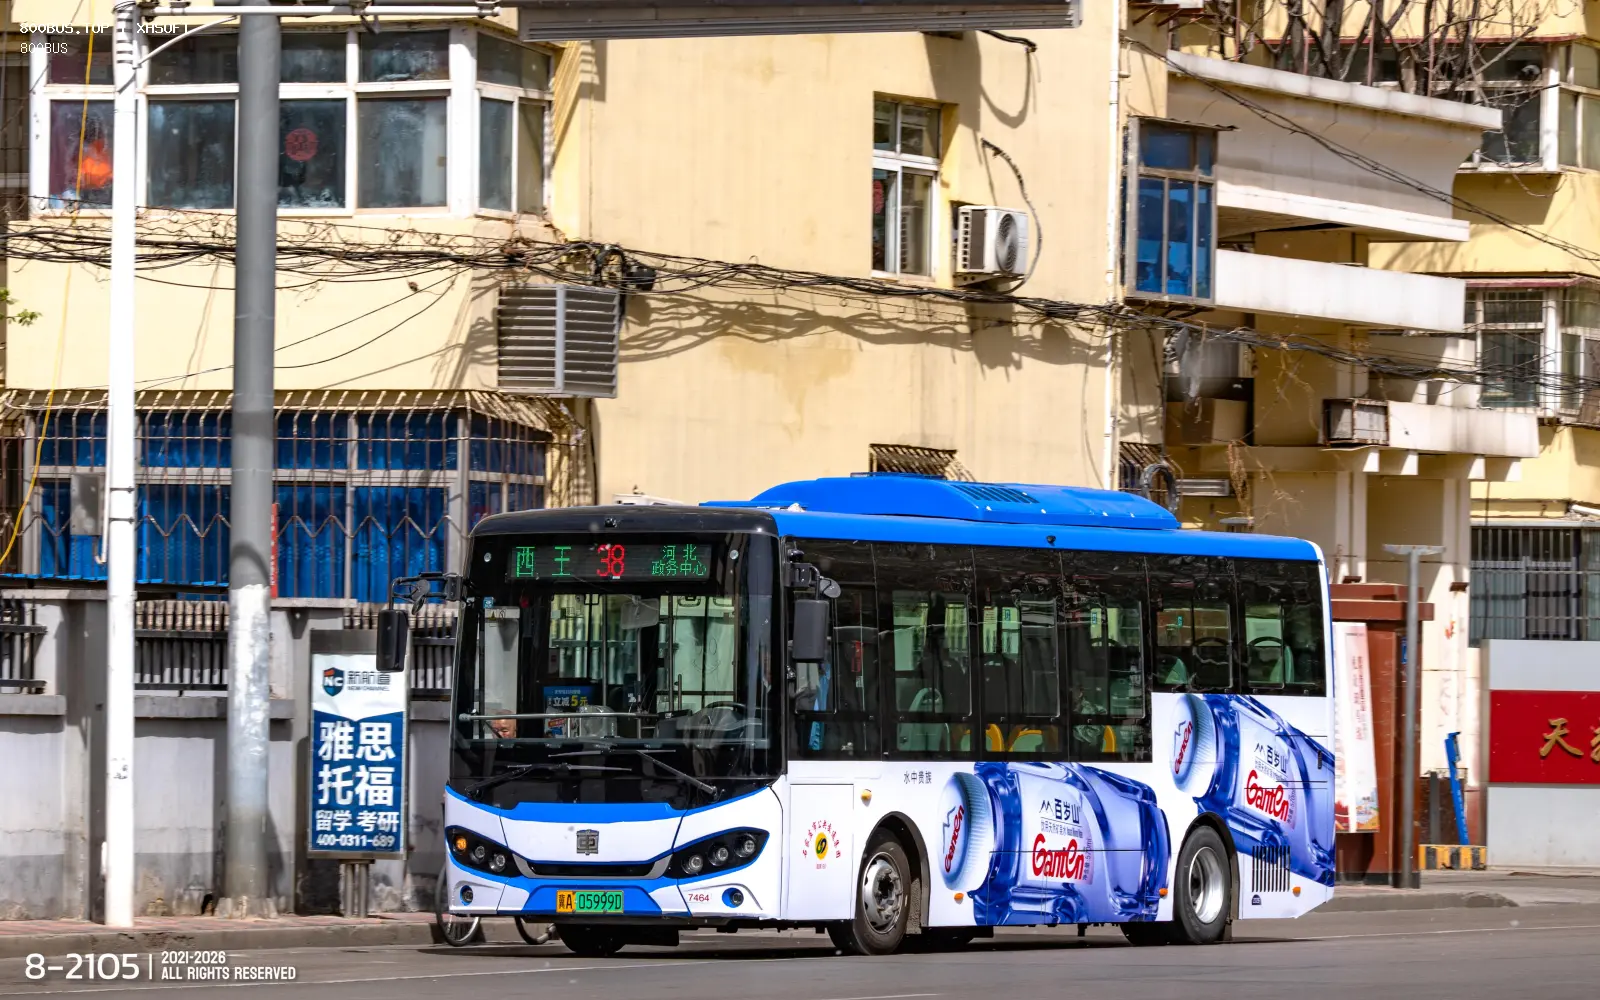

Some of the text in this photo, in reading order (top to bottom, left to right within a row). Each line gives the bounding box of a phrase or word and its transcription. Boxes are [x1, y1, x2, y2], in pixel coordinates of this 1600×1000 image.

[515, 544, 625, 577] 西王 38
[662, 543, 697, 560] 河北
[651, 560, 707, 576] 政务中心
[318, 720, 396, 762] 雅思
[1539, 717, 1600, 763] 天
[1267, 745, 1287, 774] 百岁山
[317, 764, 395, 806] 托福
[903, 770, 932, 784] 水中贵族
[315, 809, 399, 833] 留学 考研
[1054, 798, 1080, 824] 百岁山
[316, 834, 395, 848] 400-0311-689
[688, 893, 710, 902] 7464
